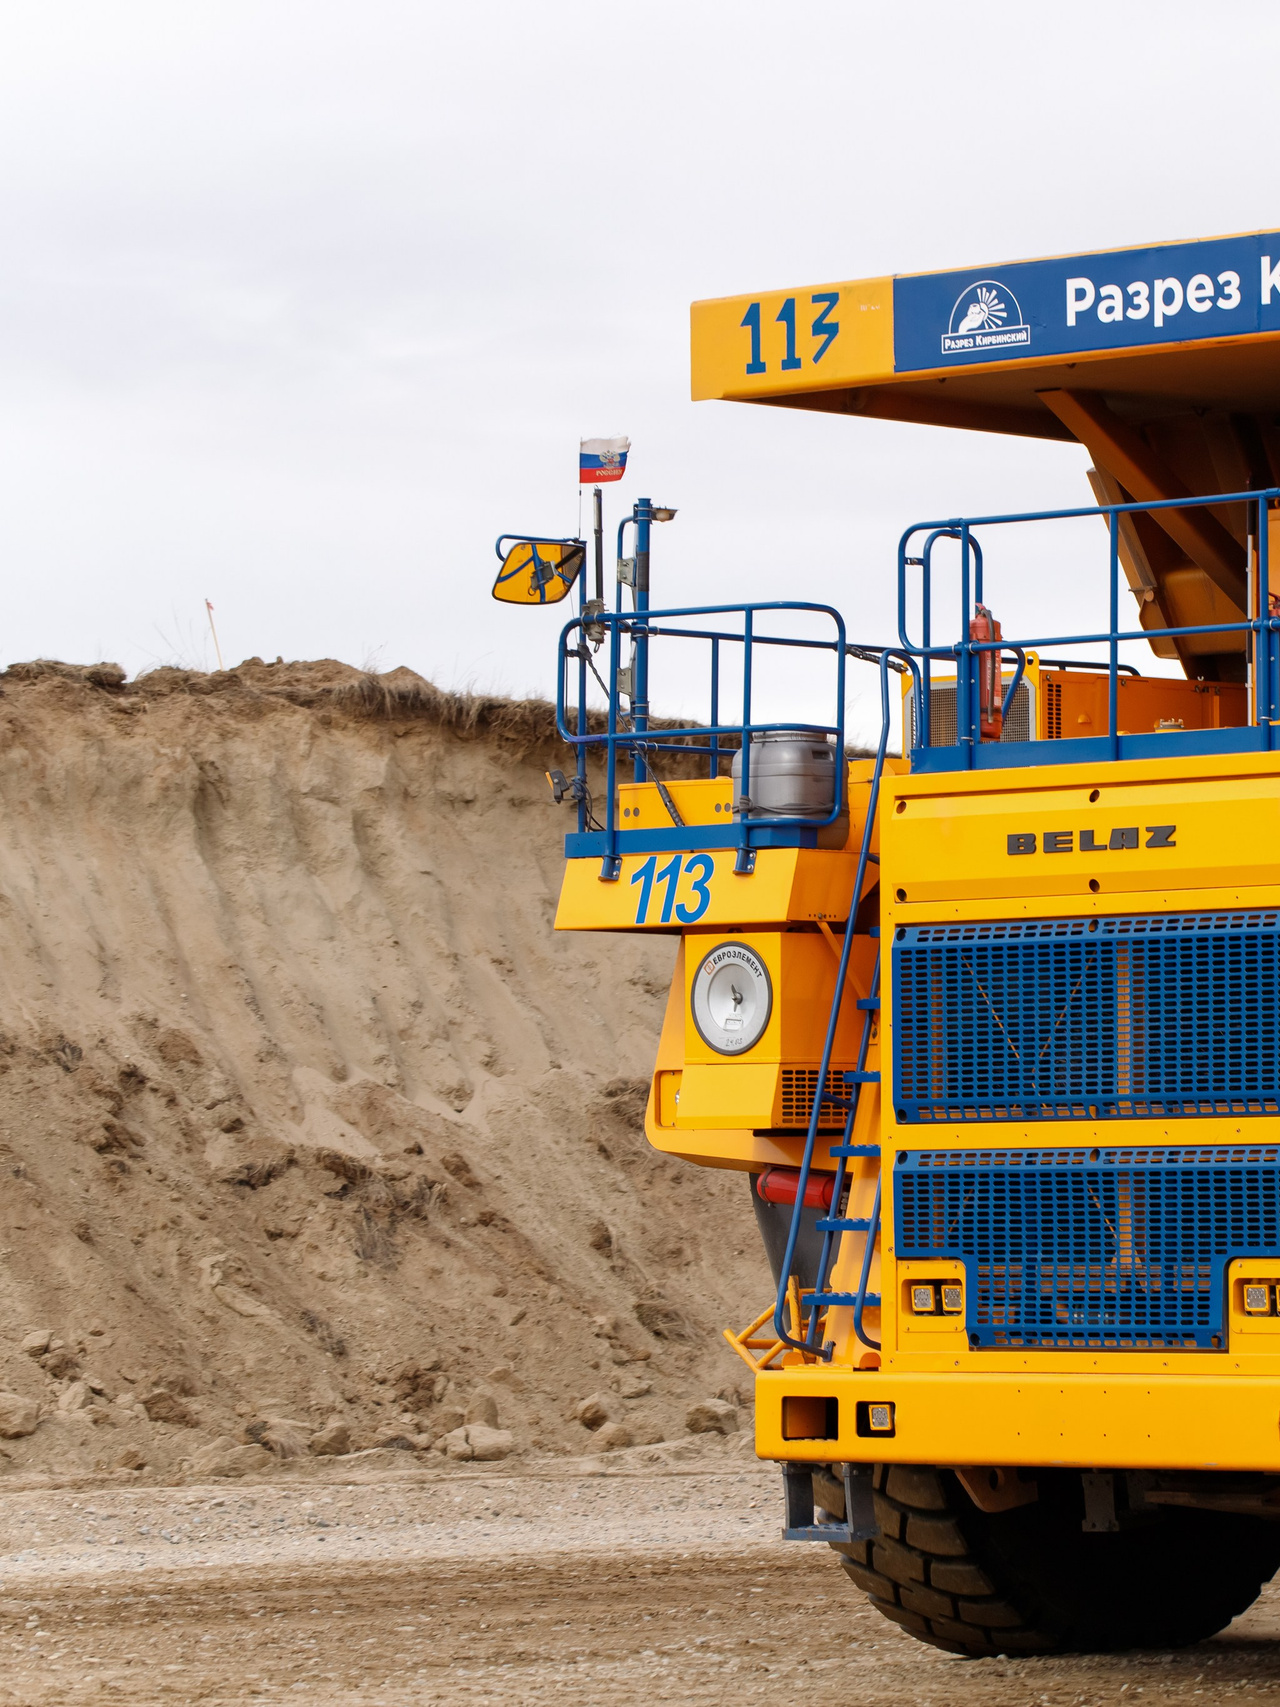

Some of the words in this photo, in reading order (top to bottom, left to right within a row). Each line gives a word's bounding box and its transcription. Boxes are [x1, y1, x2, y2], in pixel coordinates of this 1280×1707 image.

[1065, 270, 1241, 328] Разрез
[740, 292, 839, 375] 113
[1006, 825, 1177, 856] BELAZ
[630, 853, 715, 924] 113
[712, 950, 763, 978] ЕВРОЭЛЕМЕНТ
